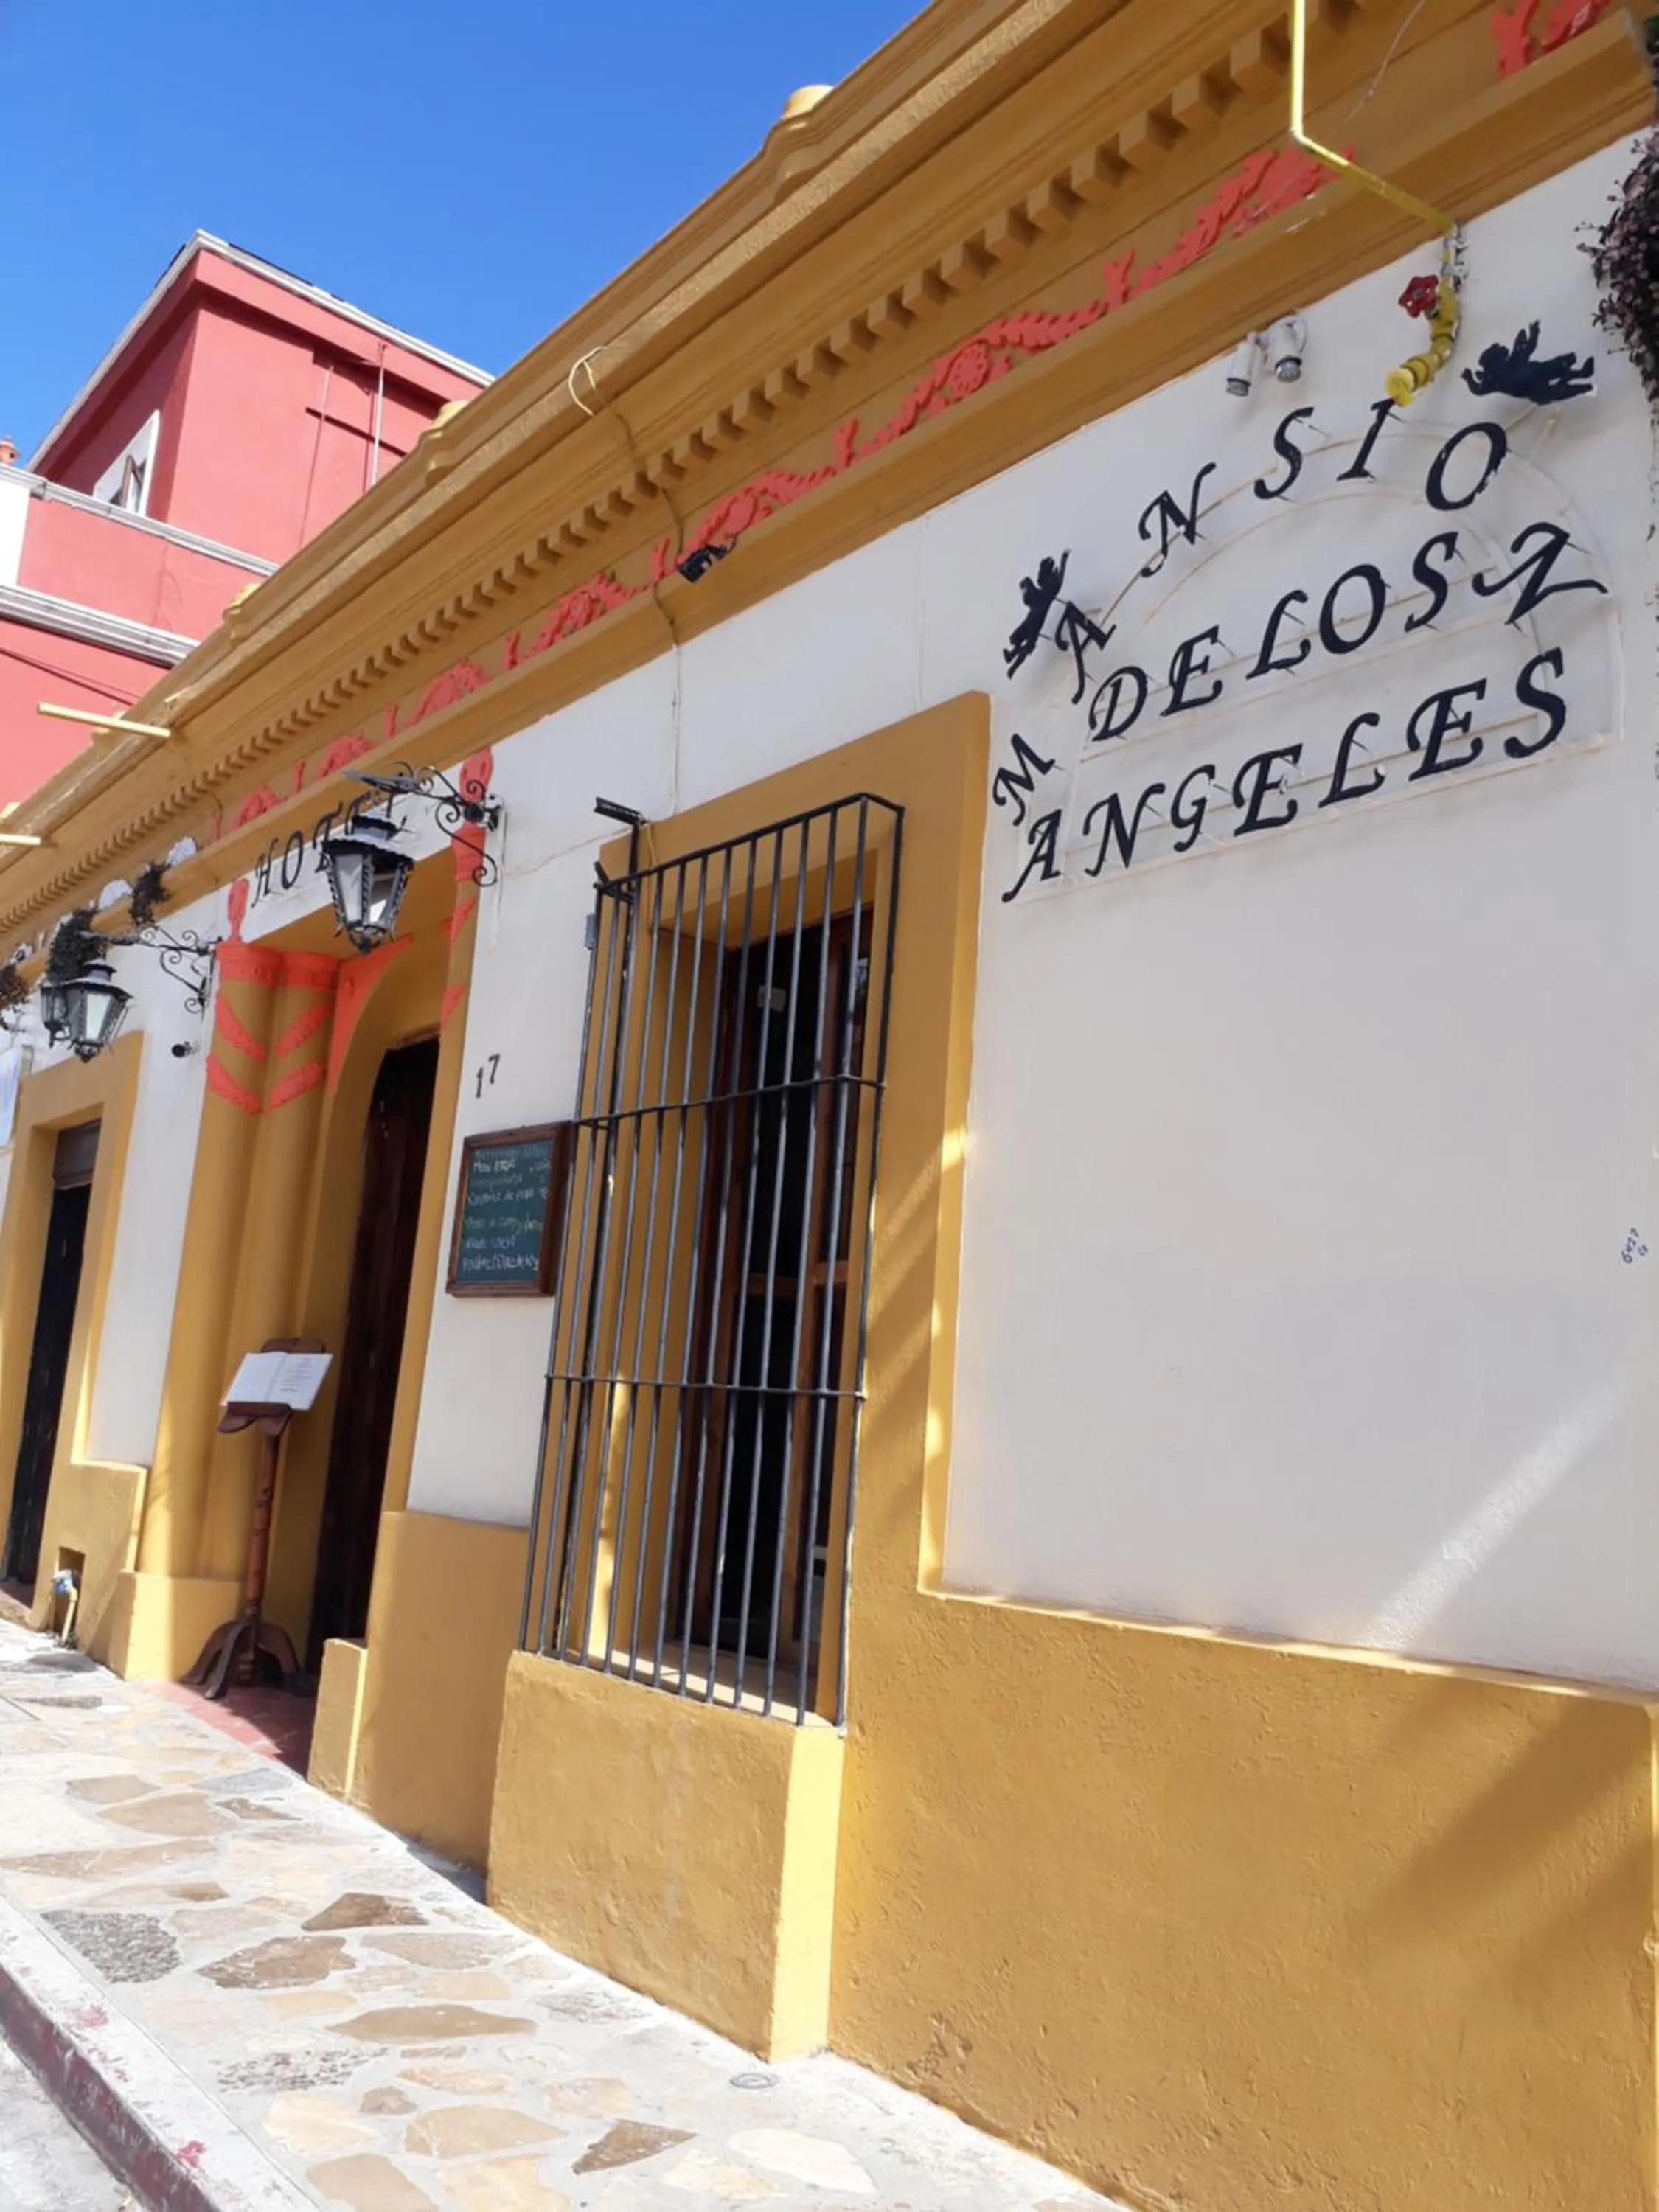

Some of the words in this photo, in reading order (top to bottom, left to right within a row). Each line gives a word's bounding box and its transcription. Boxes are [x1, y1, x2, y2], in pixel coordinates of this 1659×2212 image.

[992, 398, 1610, 827] MANSION
[1088, 625, 1224, 742] DE
[1245, 531, 1459, 682] LOS
[1001, 647, 1567, 904] ANGELES
[476, 1053, 501, 1099] 17
